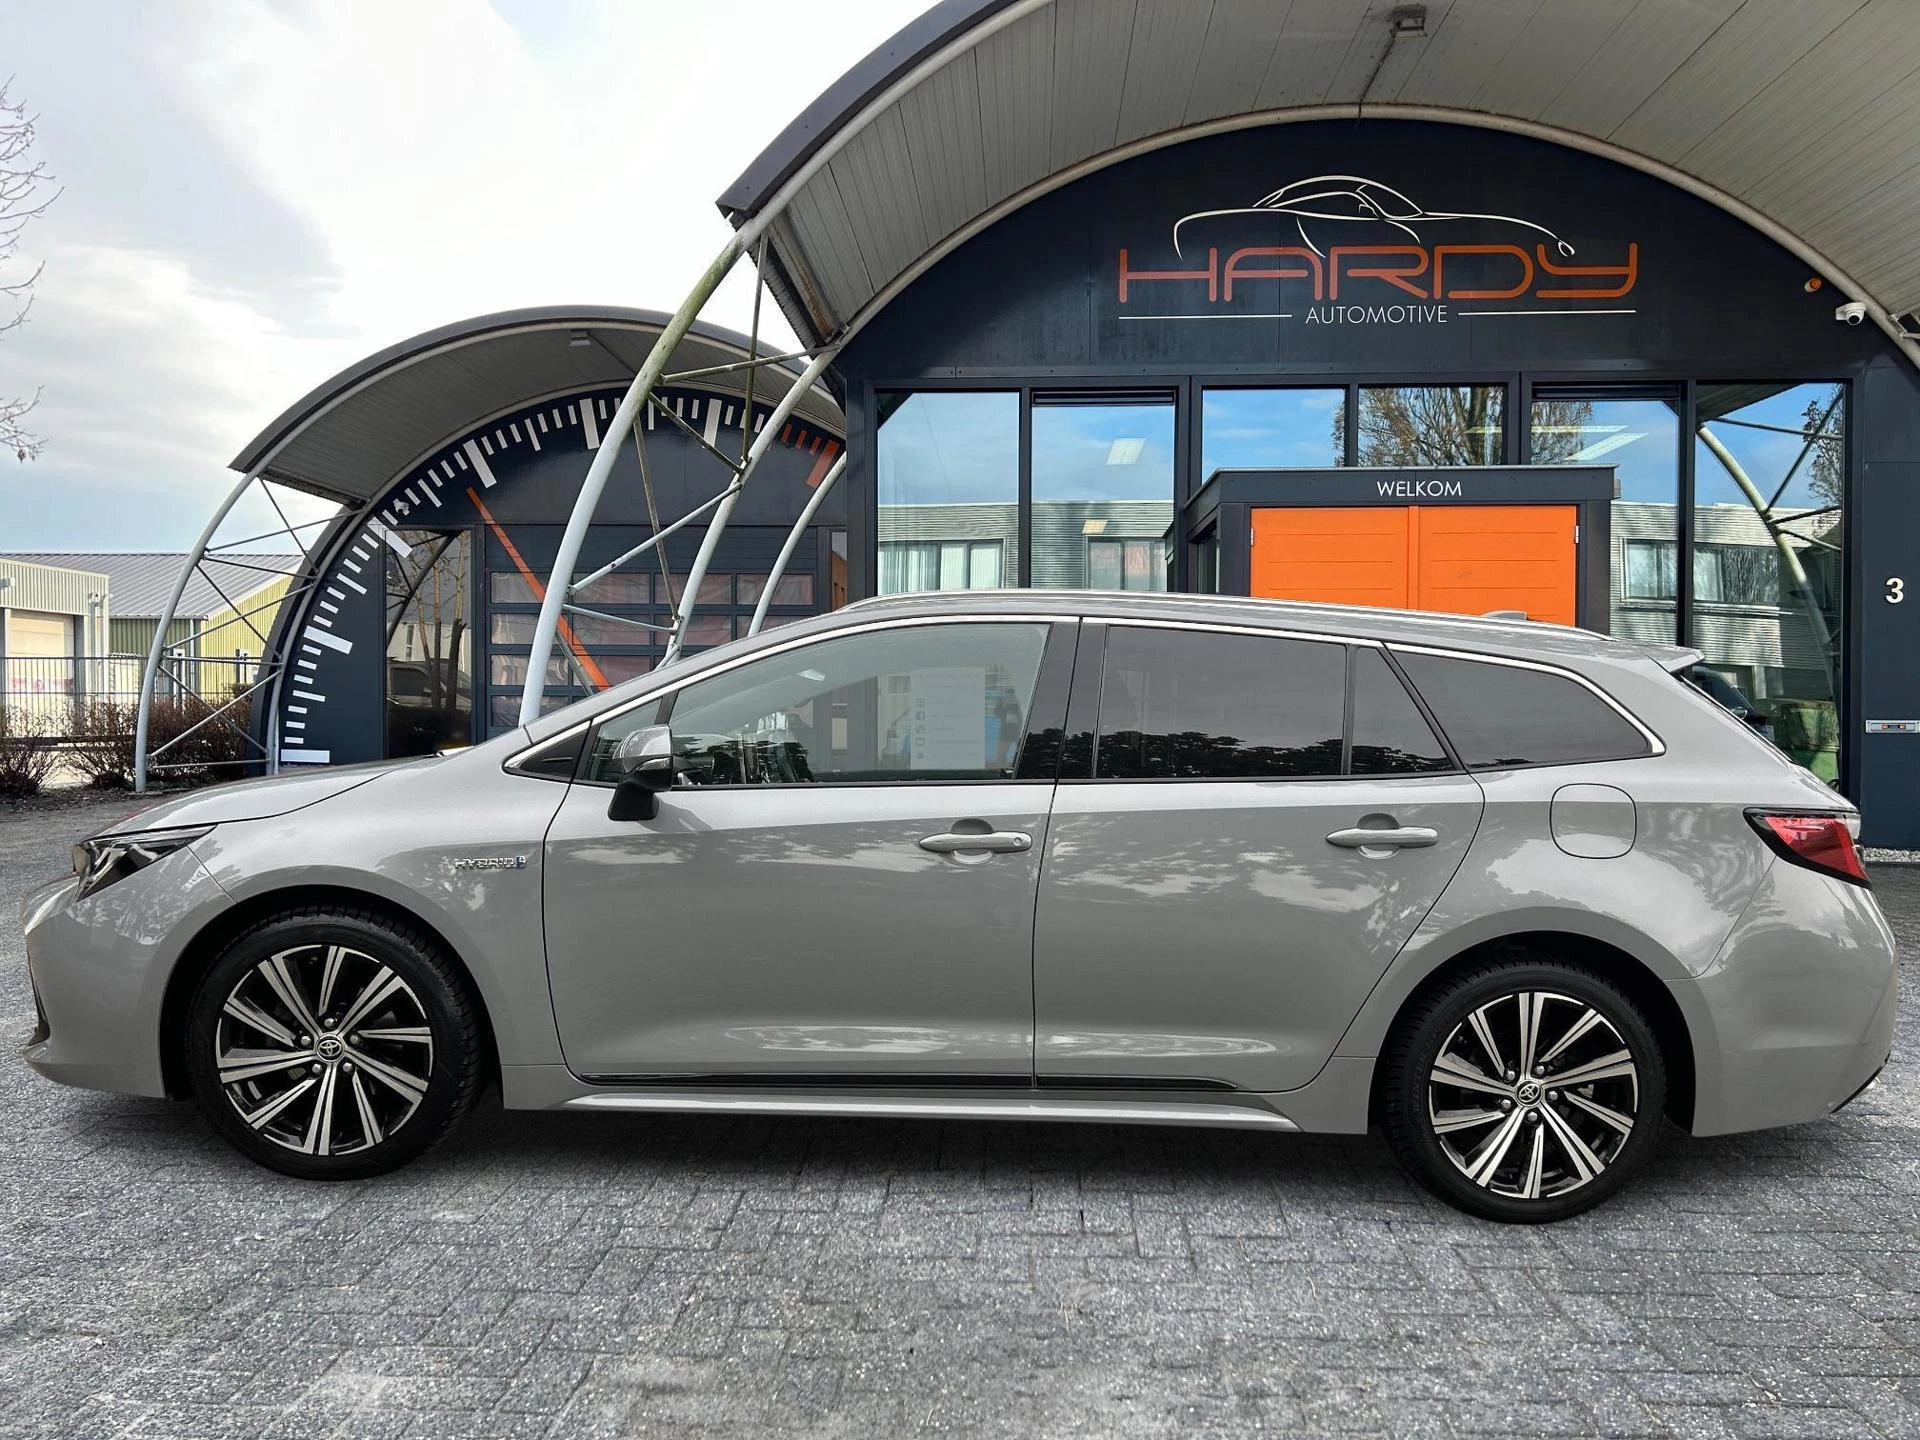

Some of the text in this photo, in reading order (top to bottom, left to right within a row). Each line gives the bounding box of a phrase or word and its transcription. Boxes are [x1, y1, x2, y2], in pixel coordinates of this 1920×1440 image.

[1119, 243, 1637, 302] HARDY
[1305, 305, 1448, 325] AUTOMOTIVE
[1376, 480, 1462, 497] WELKOM
[1885, 577, 1904, 604] 3
